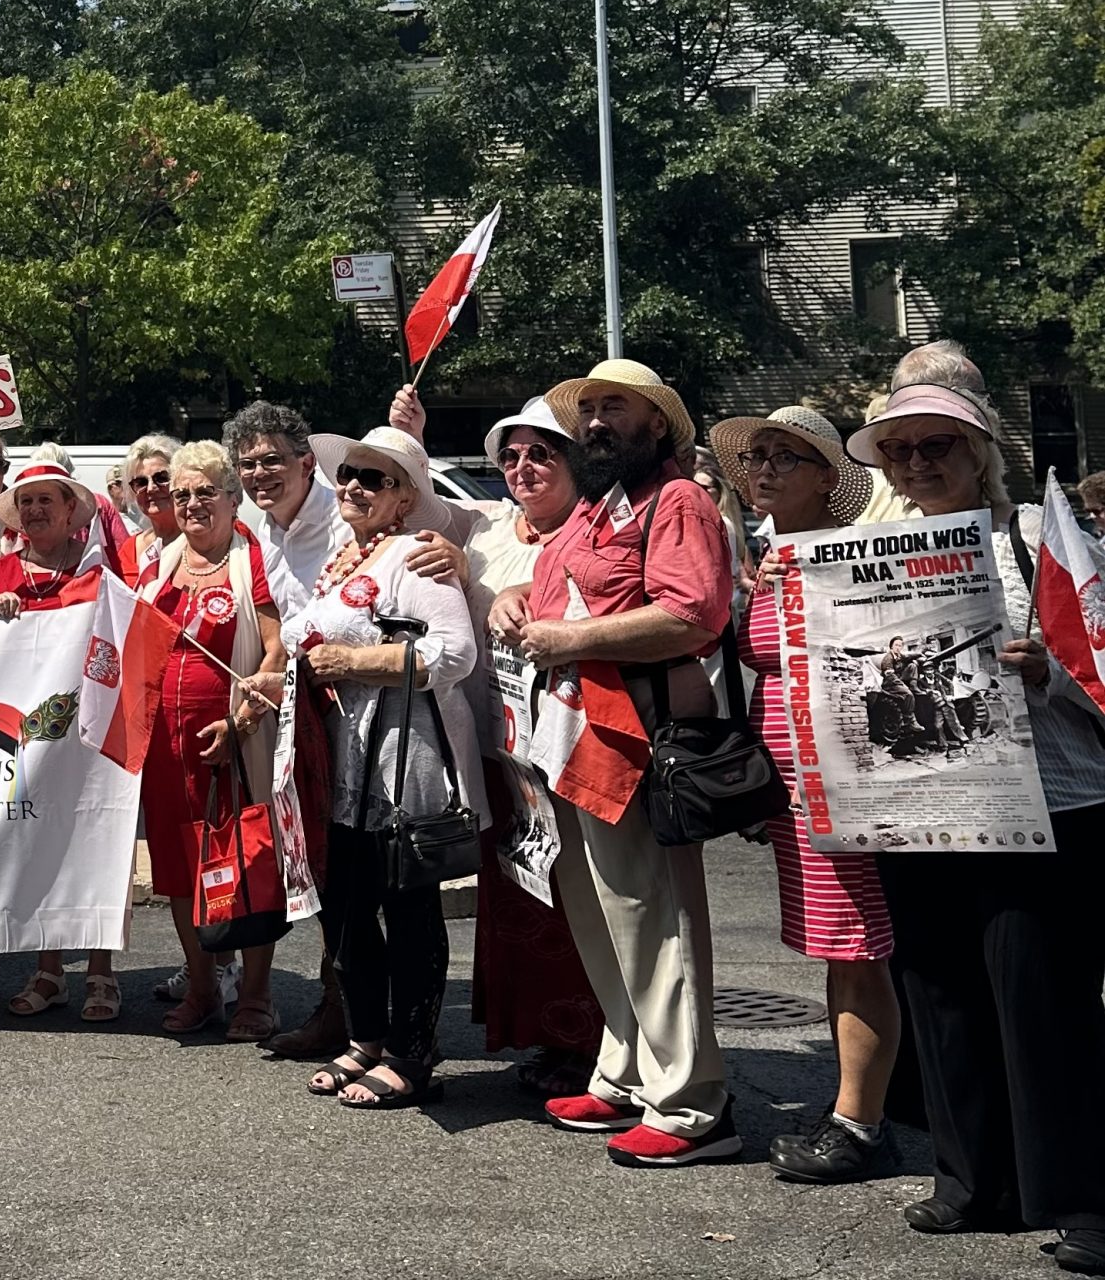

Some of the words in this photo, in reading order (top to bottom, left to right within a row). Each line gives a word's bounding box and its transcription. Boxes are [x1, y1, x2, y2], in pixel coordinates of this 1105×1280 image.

[809, 539, 869, 565] JERZY
[872, 532, 929, 557] ODON
[932, 521, 982, 549] WOŚ
[852, 563, 895, 584] AKA
[895, 550, 985, 578] "DONAT"
[970, 573, 990, 582] 2011
[777, 544, 808, 648] WARSAW
[879, 592, 913, 603] Corporal
[787, 654, 819, 767] UPRISING
[802, 771, 833, 836] HERO
